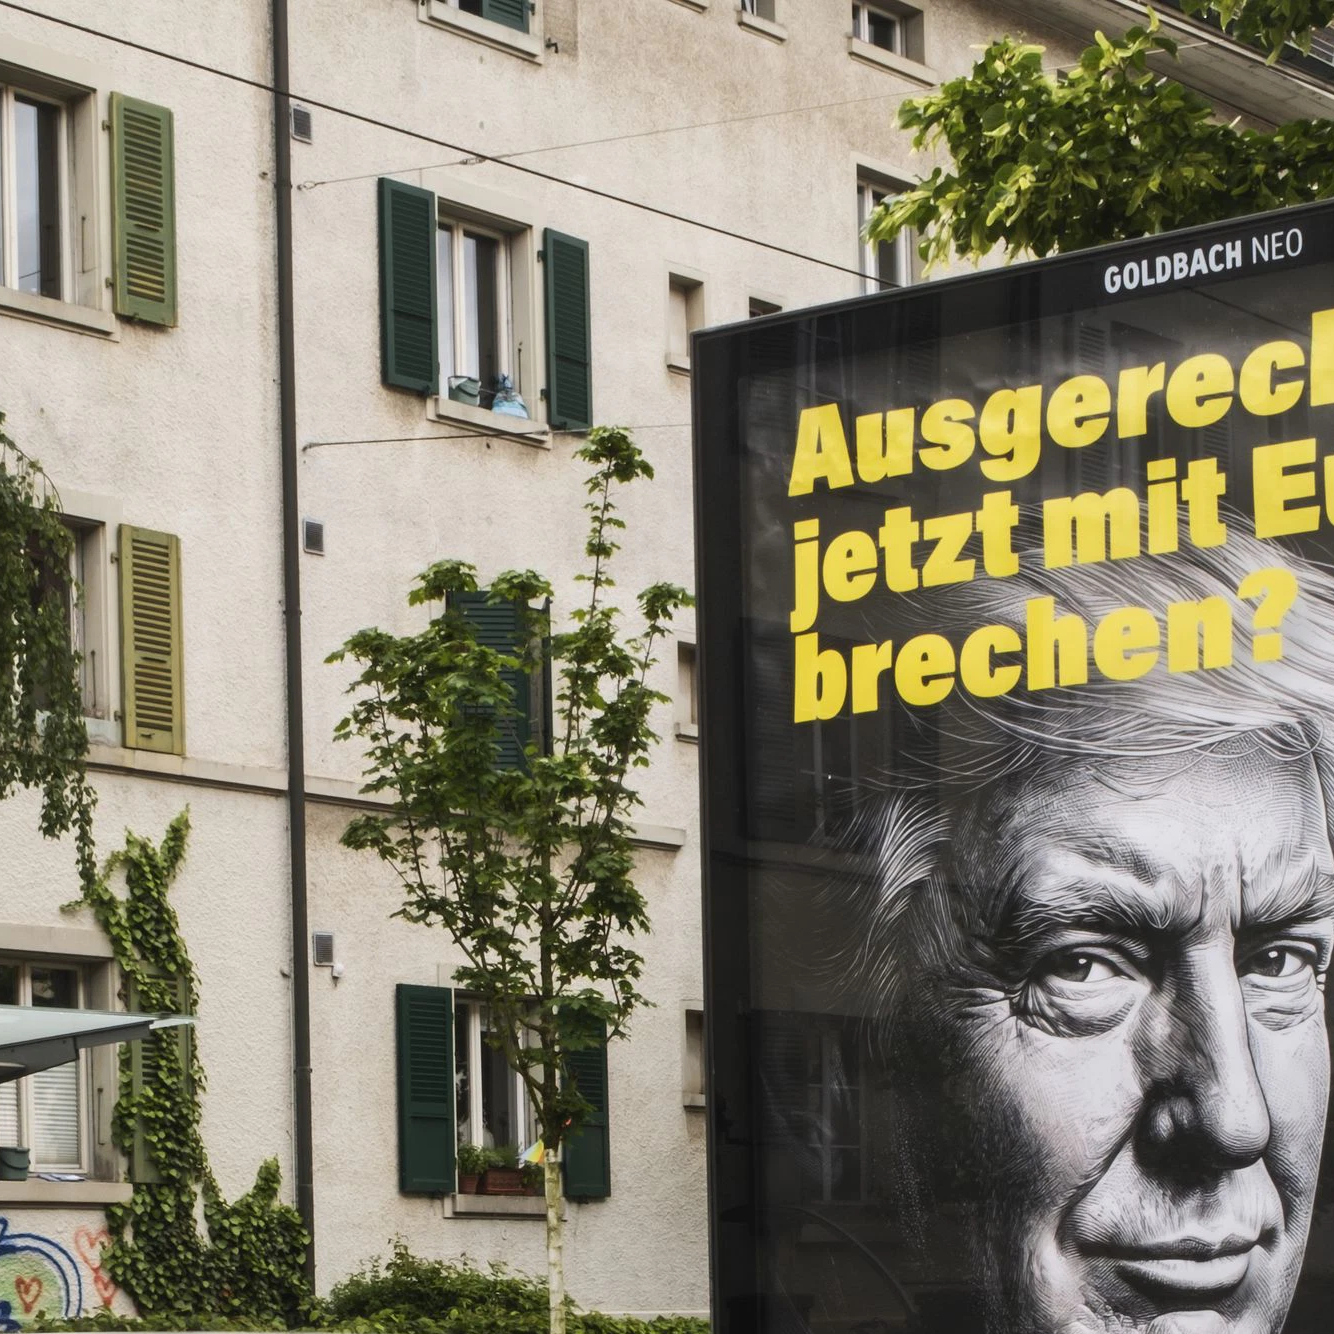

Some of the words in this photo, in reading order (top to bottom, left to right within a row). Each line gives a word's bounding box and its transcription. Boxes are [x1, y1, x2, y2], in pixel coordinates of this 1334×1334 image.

[1103, 239, 1242, 294] GOLDBACH
[1251, 228, 1303, 264] NEO
[790, 490, 1021, 632] jetzt
[1042, 455, 1229, 571] mit
[794, 570, 1298, 724] brechen?
